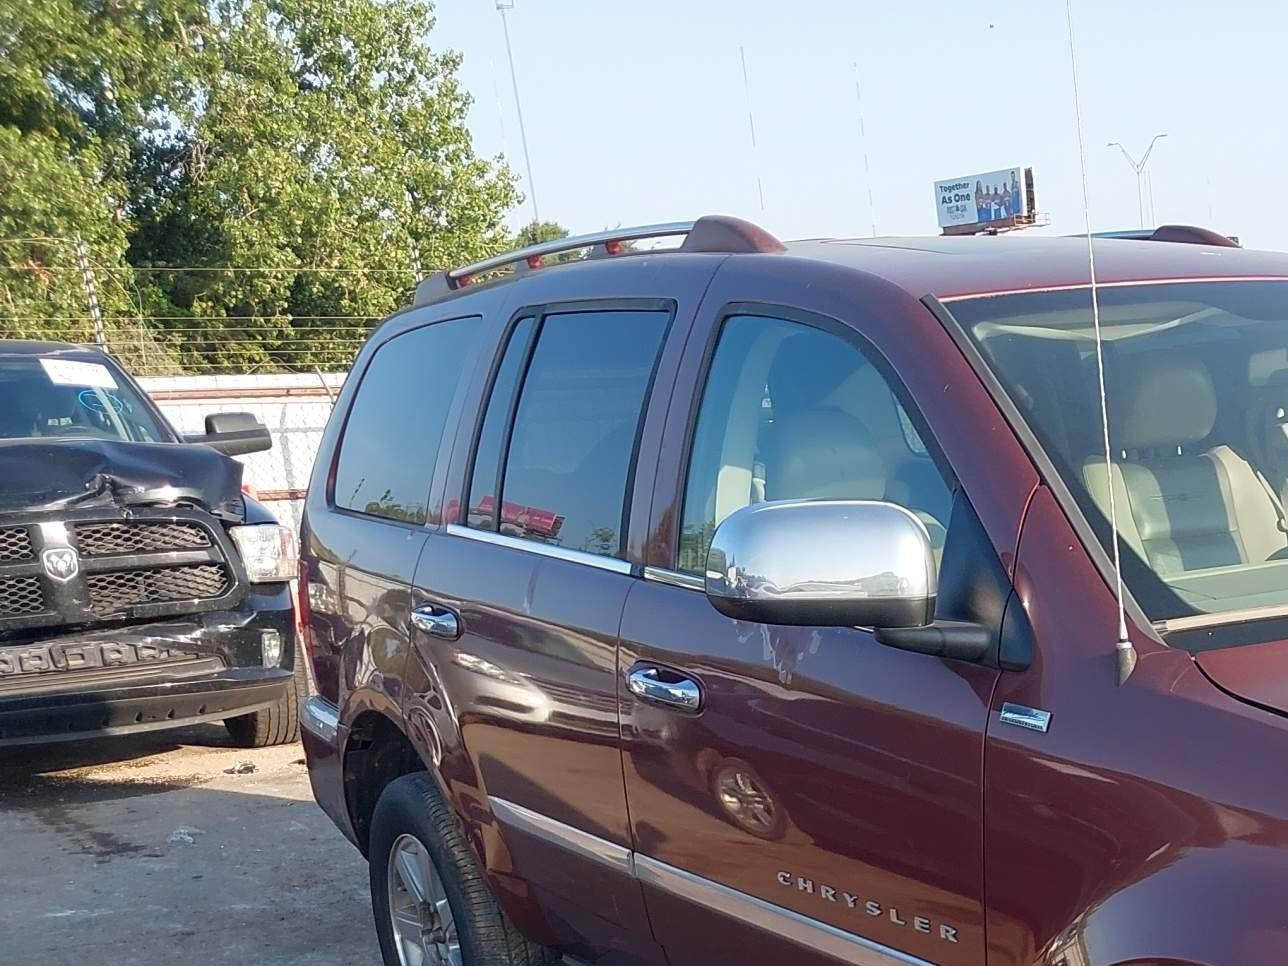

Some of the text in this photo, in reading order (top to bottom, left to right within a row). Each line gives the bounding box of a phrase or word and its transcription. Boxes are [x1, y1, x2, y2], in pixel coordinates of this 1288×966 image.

[939, 182, 970, 193] Together
[941, 193, 971, 204] As One
[777, 871, 960, 943] CHRYSLER
